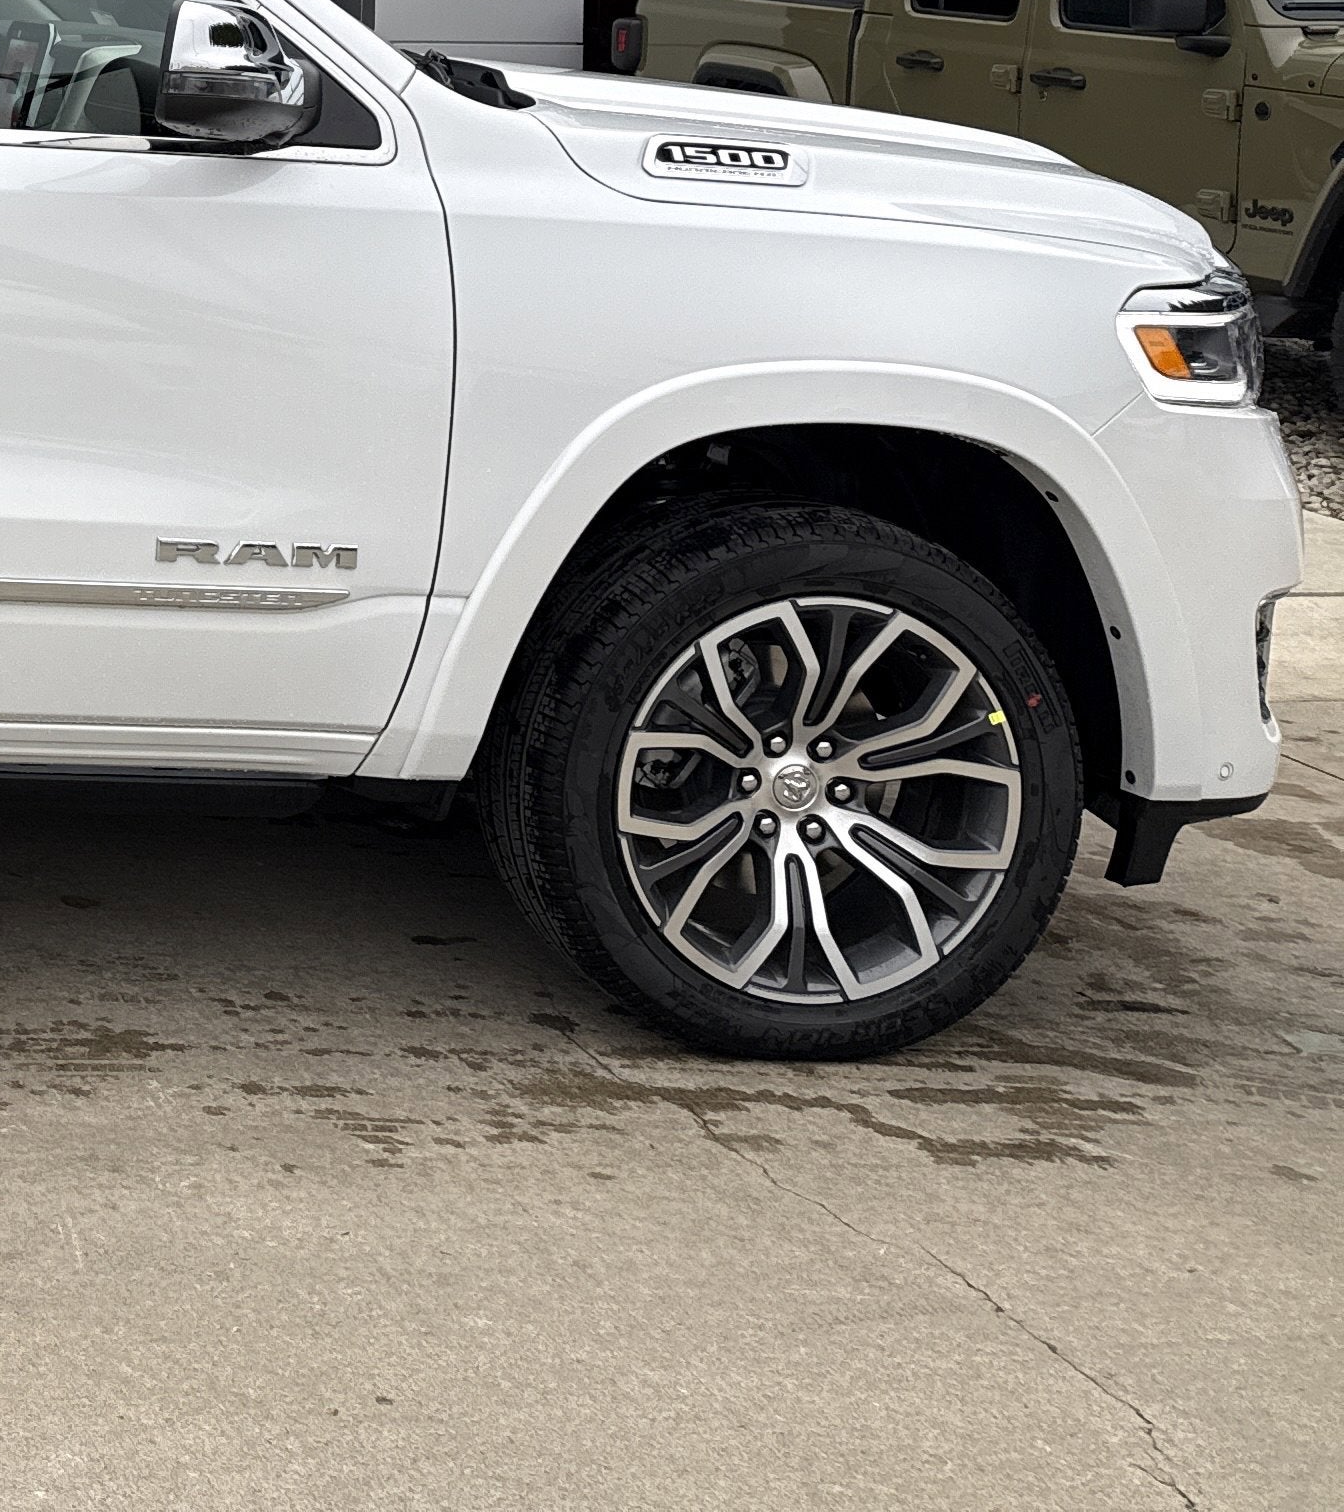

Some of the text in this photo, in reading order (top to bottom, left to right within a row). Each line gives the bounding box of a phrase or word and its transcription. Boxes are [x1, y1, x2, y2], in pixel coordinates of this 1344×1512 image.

[663, 145, 786, 168] 1500
[1244, 198, 1294, 227] Jeep
[154, 535, 359, 570] RAM
